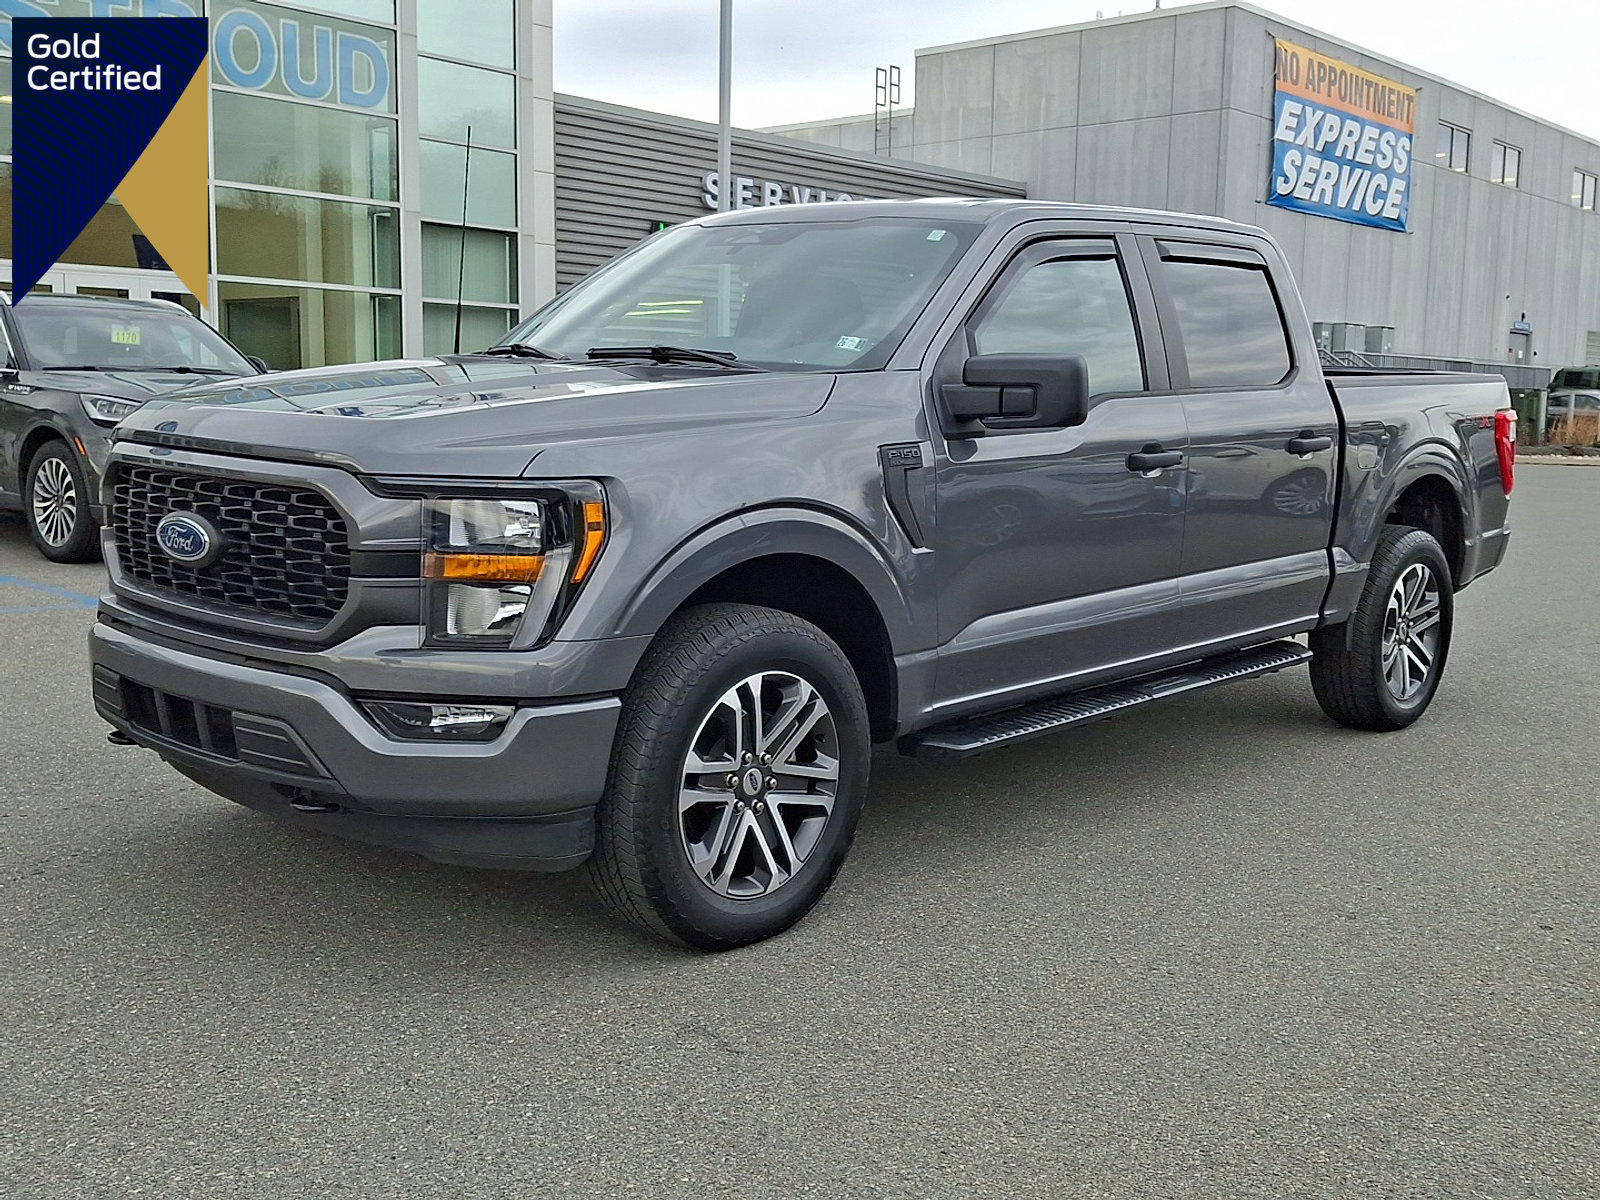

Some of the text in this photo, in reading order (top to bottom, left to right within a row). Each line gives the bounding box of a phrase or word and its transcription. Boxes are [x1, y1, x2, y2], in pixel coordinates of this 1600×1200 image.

[1276, 46, 1414, 125] NO APPOINTMENT
[1275, 99, 1411, 174] EXPRESS
[1276, 149, 1406, 220] SERVICE
[888, 448, 921, 459] F-150
[165, 525, 194, 552] Ford
